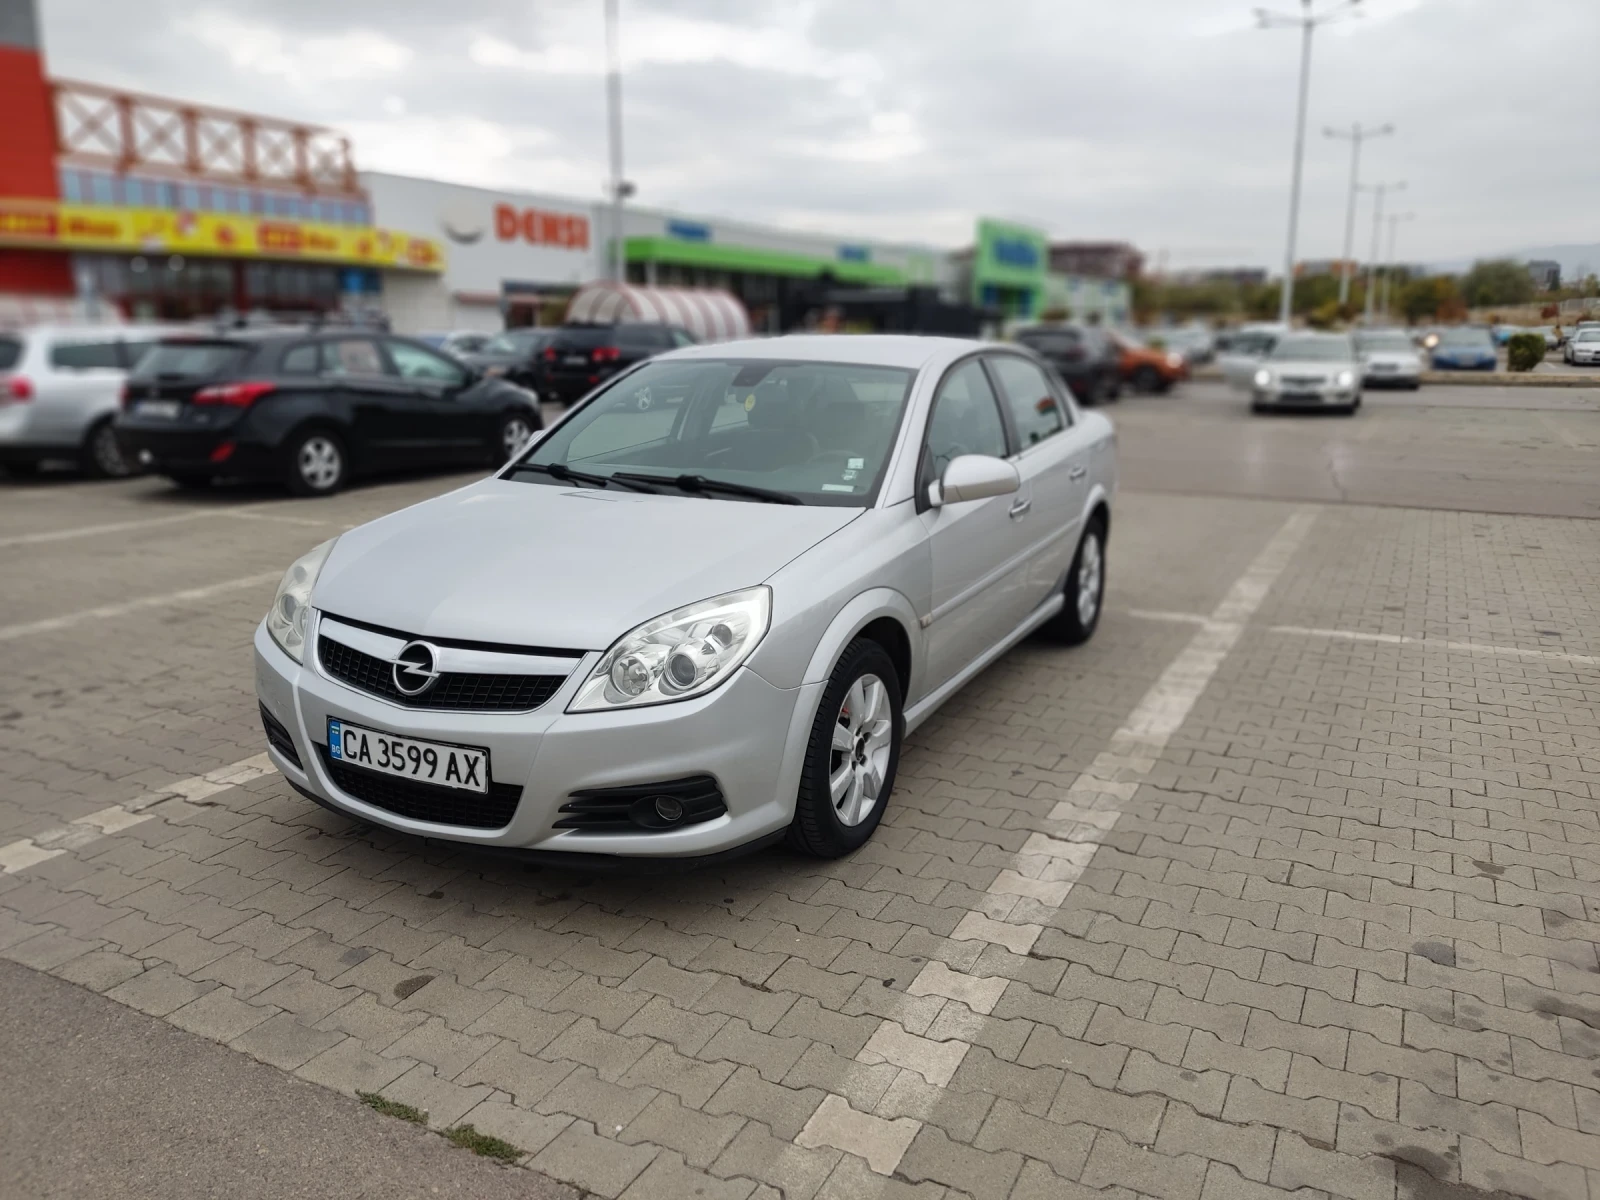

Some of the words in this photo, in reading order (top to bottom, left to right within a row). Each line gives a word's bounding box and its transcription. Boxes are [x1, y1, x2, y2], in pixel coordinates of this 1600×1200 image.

[331, 743, 341, 755] BG
[343, 729, 372, 765] CA
[377, 738, 438, 779] 3599
[445, 752, 481, 787] AX
